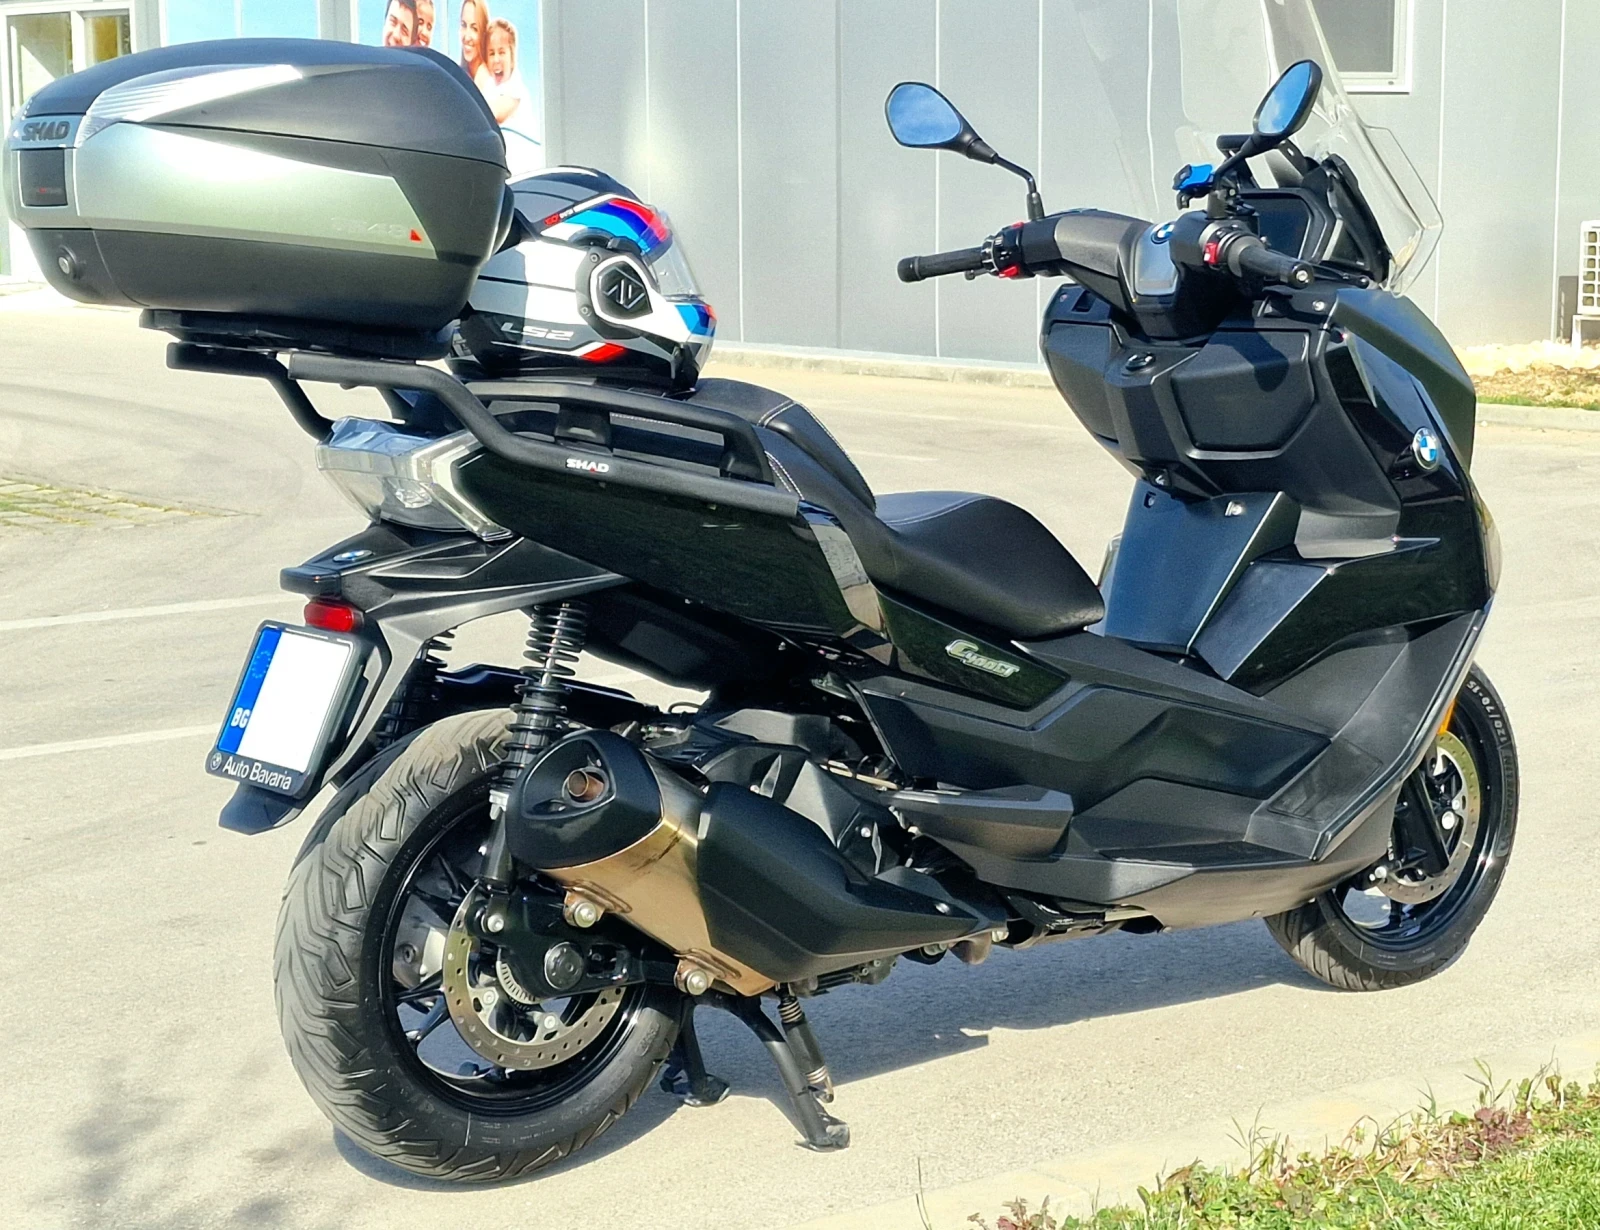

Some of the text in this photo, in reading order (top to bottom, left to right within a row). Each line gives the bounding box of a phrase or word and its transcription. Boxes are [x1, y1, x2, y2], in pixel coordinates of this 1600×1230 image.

[21, 121, 71, 141] SHAD
[500, 322, 575, 341] LS2
[566, 458, 610, 473] SHAD
[230, 707, 251, 729] BG
[1466, 680, 1508, 743] 120/70-15
[222, 756, 292, 791] Auto Bavaria
